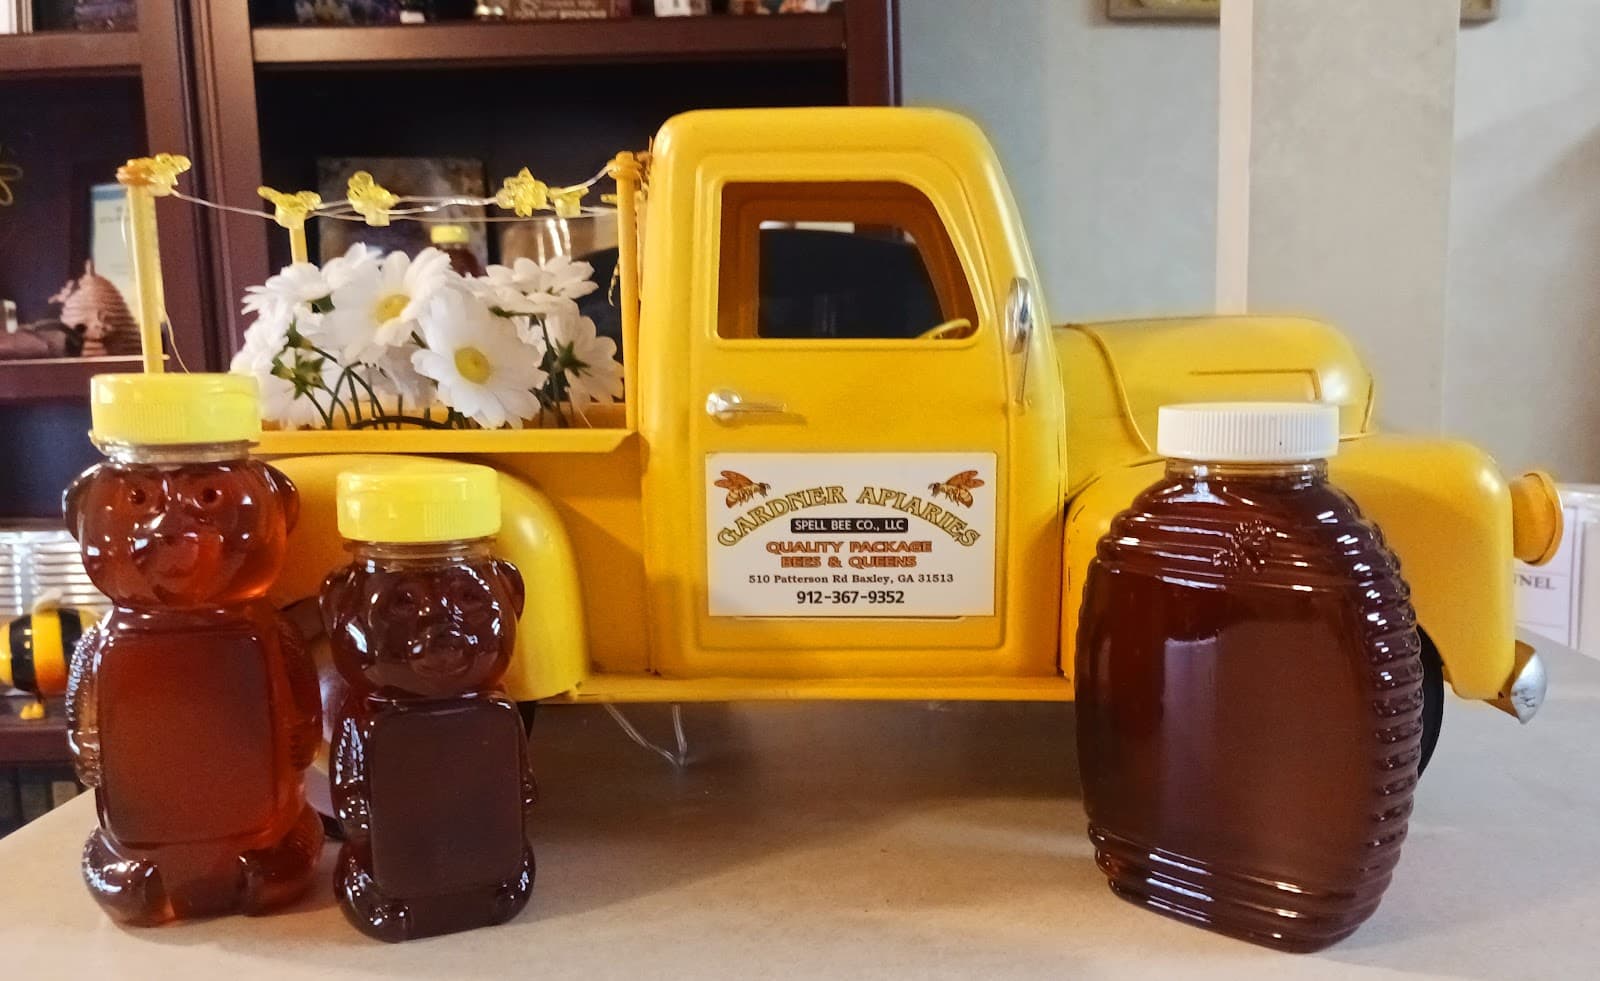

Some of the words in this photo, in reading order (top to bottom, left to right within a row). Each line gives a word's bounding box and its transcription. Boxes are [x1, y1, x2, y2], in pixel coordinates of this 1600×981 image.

[717, 485, 848, 547] GARDNER
[856, 486, 981, 547] APIARIES
[795, 520, 826, 531] SPELL
[831, 520, 852, 531] BEE
[856, 520, 880, 533] CO.,
[885, 520, 904, 531] LLC
[766, 541, 844, 553] QUALITY
[849, 541, 932, 553] PACKAGE
[781, 556, 822, 568] BEES
[828, 556, 842, 568] &
[849, 556, 917, 568] QUEENS
[748, 574, 770, 584] 510
[774, 574, 828, 584] Patterson
[832, 574, 848, 584] Rd
[852, 574, 894, 585] Baxley,
[898, 574, 914, 584] GA
[918, 574, 954, 584] 31513
[796, 590, 905, 604] 912-367-9352
